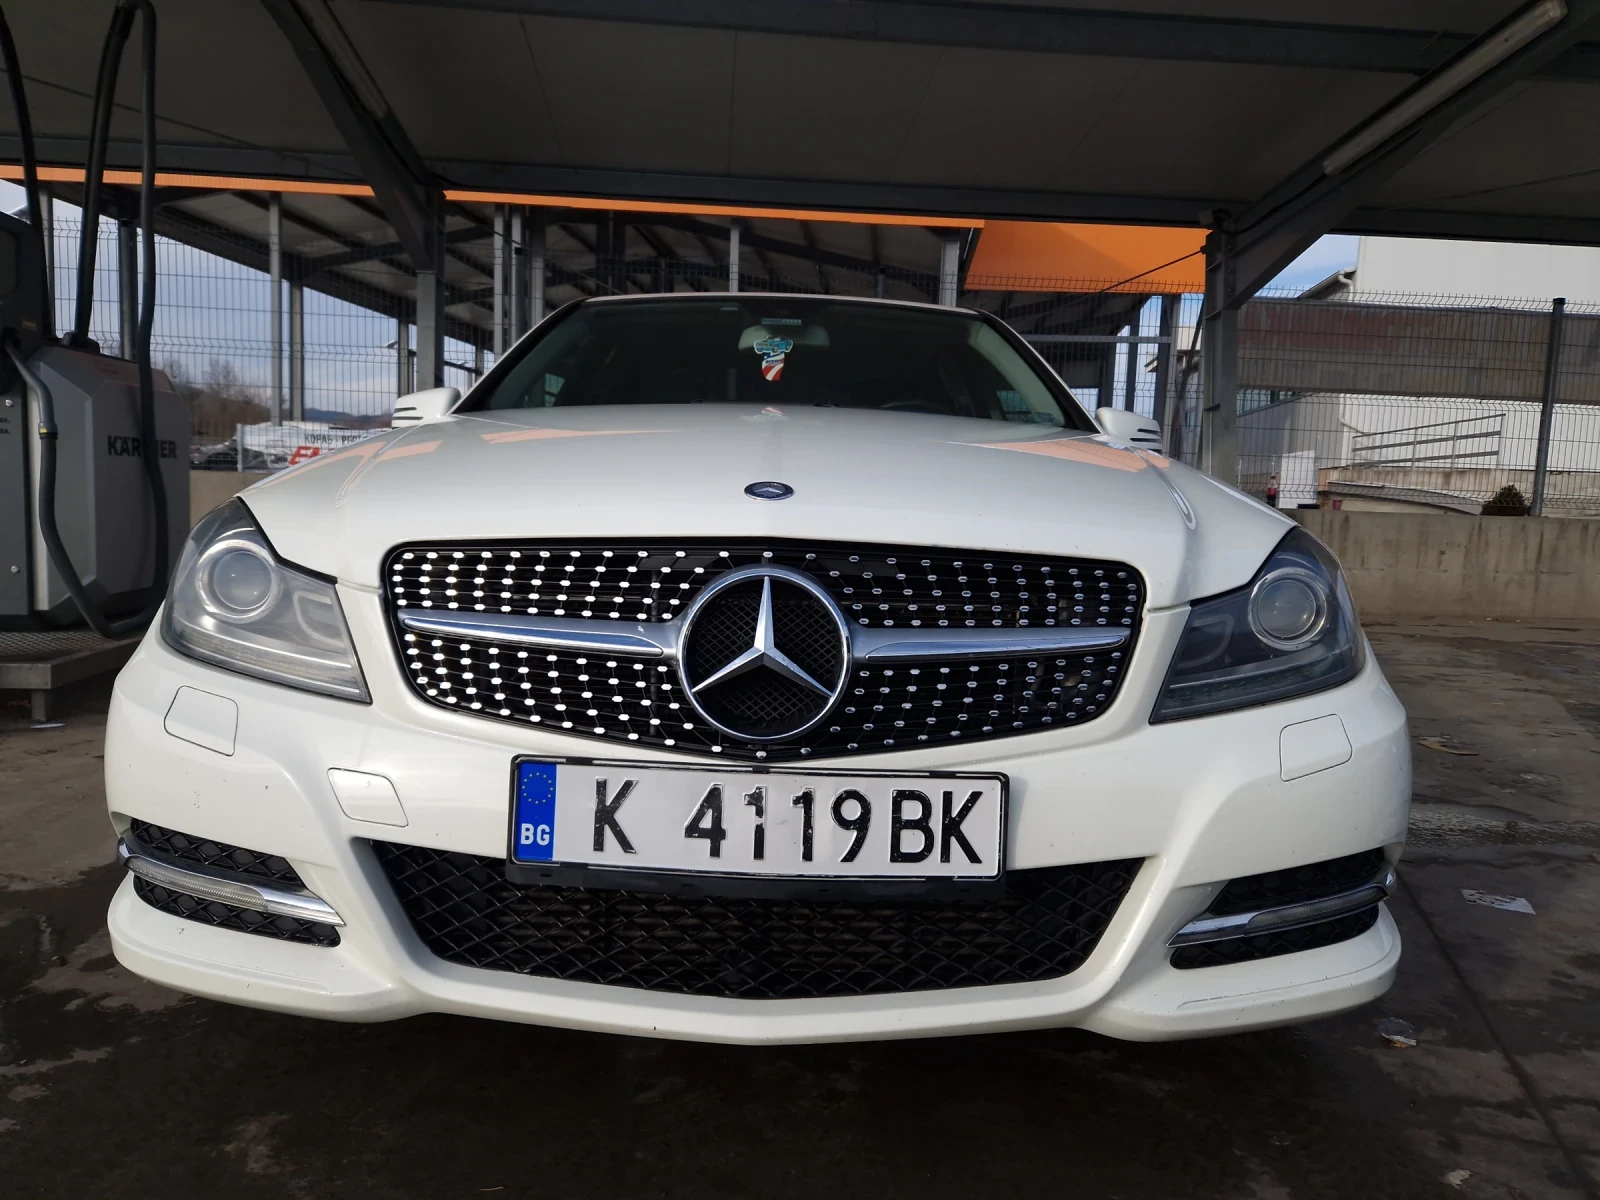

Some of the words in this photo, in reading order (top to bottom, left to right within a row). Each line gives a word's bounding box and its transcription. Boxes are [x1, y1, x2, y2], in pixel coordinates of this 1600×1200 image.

[107, 434, 177, 459] KÄRER
[592, 777, 639, 854] K
[519, 822, 551, 847] BG
